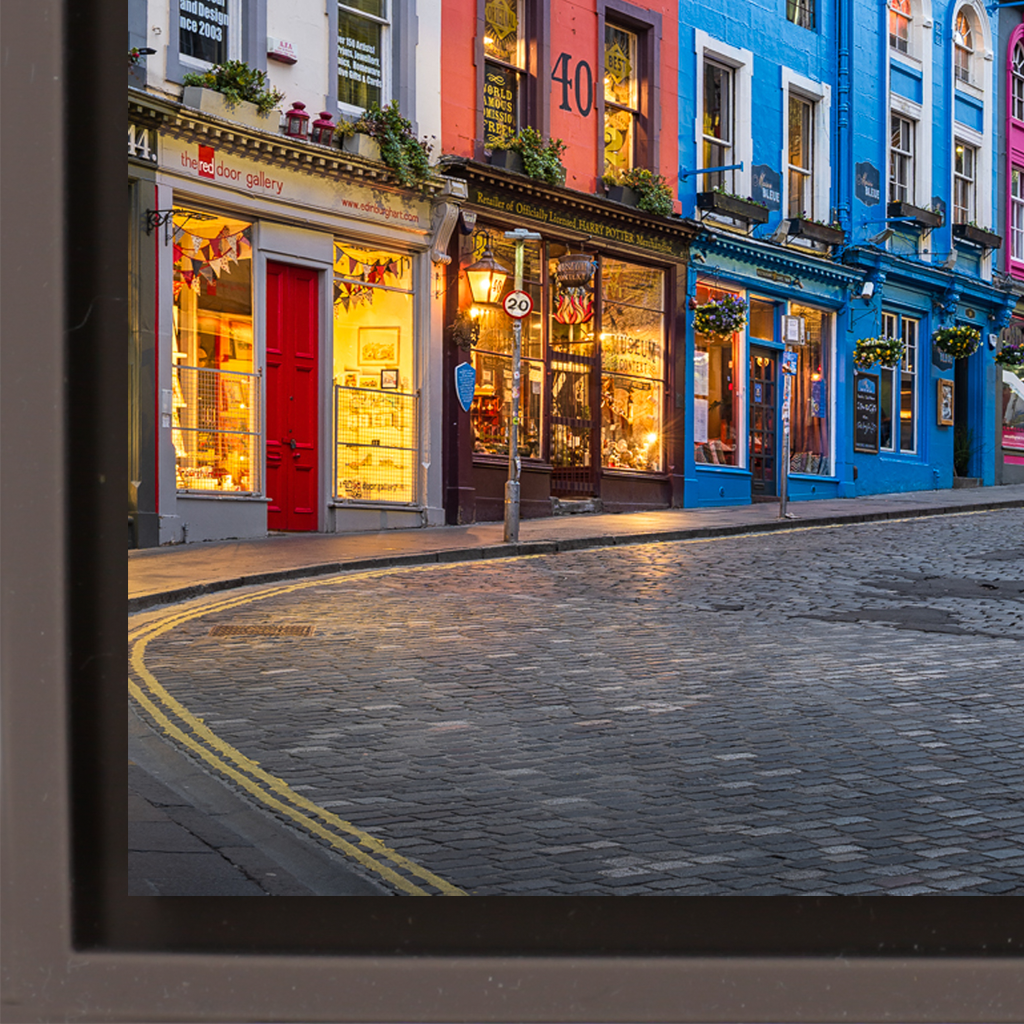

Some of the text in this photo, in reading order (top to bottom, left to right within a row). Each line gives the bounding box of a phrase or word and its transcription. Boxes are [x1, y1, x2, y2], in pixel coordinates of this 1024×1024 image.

[199, 2, 229, 26] Design
[199, 21, 223, 43] 2003
[608, 55, 627, 73] BEST
[551, 52, 593, 117] 40
[181, 150, 284, 195] the red door gallery
[762, 187, 780, 203] BLEUE
[865, 185, 880, 200] BLEUE
[341, 198, 419, 223] www.edinburghart.com
[477, 191, 505, 210] Retailer
[506, 200, 515, 212] of
[516, 202, 549, 223] Officially
[605, 225, 635, 244] POTTER
[507, 297, 529, 312] 20
